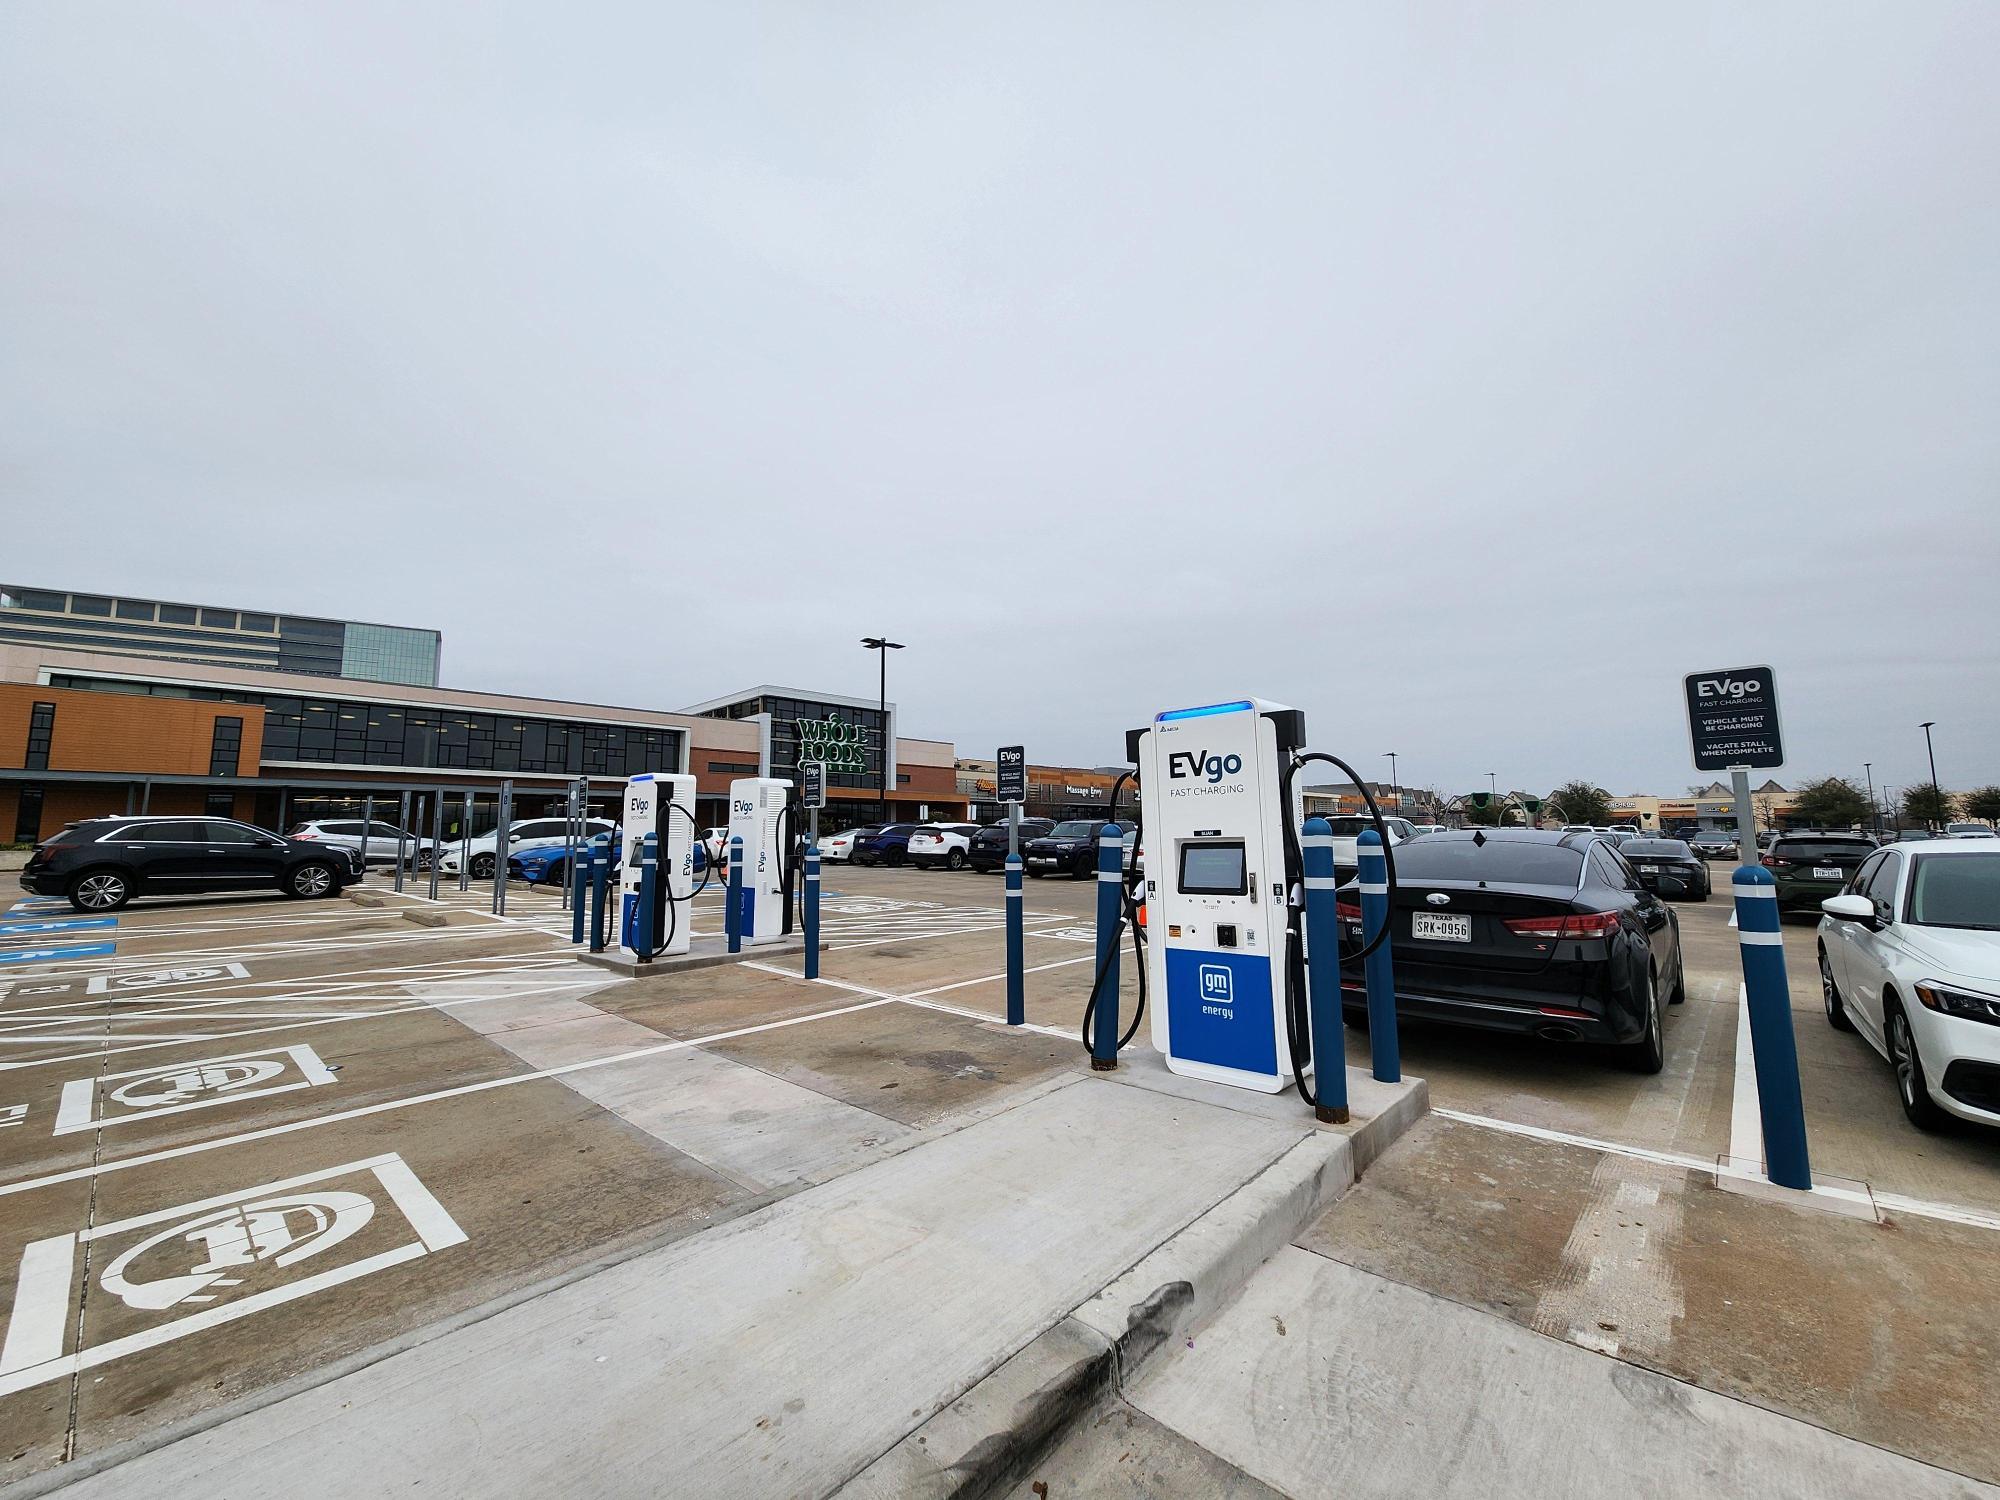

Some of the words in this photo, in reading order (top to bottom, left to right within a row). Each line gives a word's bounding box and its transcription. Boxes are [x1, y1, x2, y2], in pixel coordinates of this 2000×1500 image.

[1697, 679, 1761, 698] EVgo
[1720, 697, 1763, 706] CHARGING
[1702, 717, 1738, 725] VEHICLE
[1740, 715, 1764, 723] MUST
[1717, 722, 1763, 731] CHARGING
[797, 717, 868, 743] WHOLE
[801, 739, 866, 764] FOODS
[1706, 742, 1740, 750] VACATE
[1740, 740, 1767, 748] STALL
[1727, 747, 1774, 755] COMPLETE
[1001, 751, 1021, 762] EVgo
[806, 767, 820, 777] EVgo
[827, 764, 863, 773] RKET
[1169, 750, 1242, 783] EVgo
[1066, 785, 1089, 797] Massage
[1090, 786, 1102, 798] Envy
[1170, 788, 1192, 797] FAST
[1193, 784, 1244, 796] CHARGING
[631, 797, 649, 814] EVgo
[734, 800, 753, 815] EVgo
[683, 853, 692, 876] EVgo
[758, 851, 766, 873] EVgo
[1205, 972, 1228, 993] gm
[1202, 1004, 1234, 1020] energy
